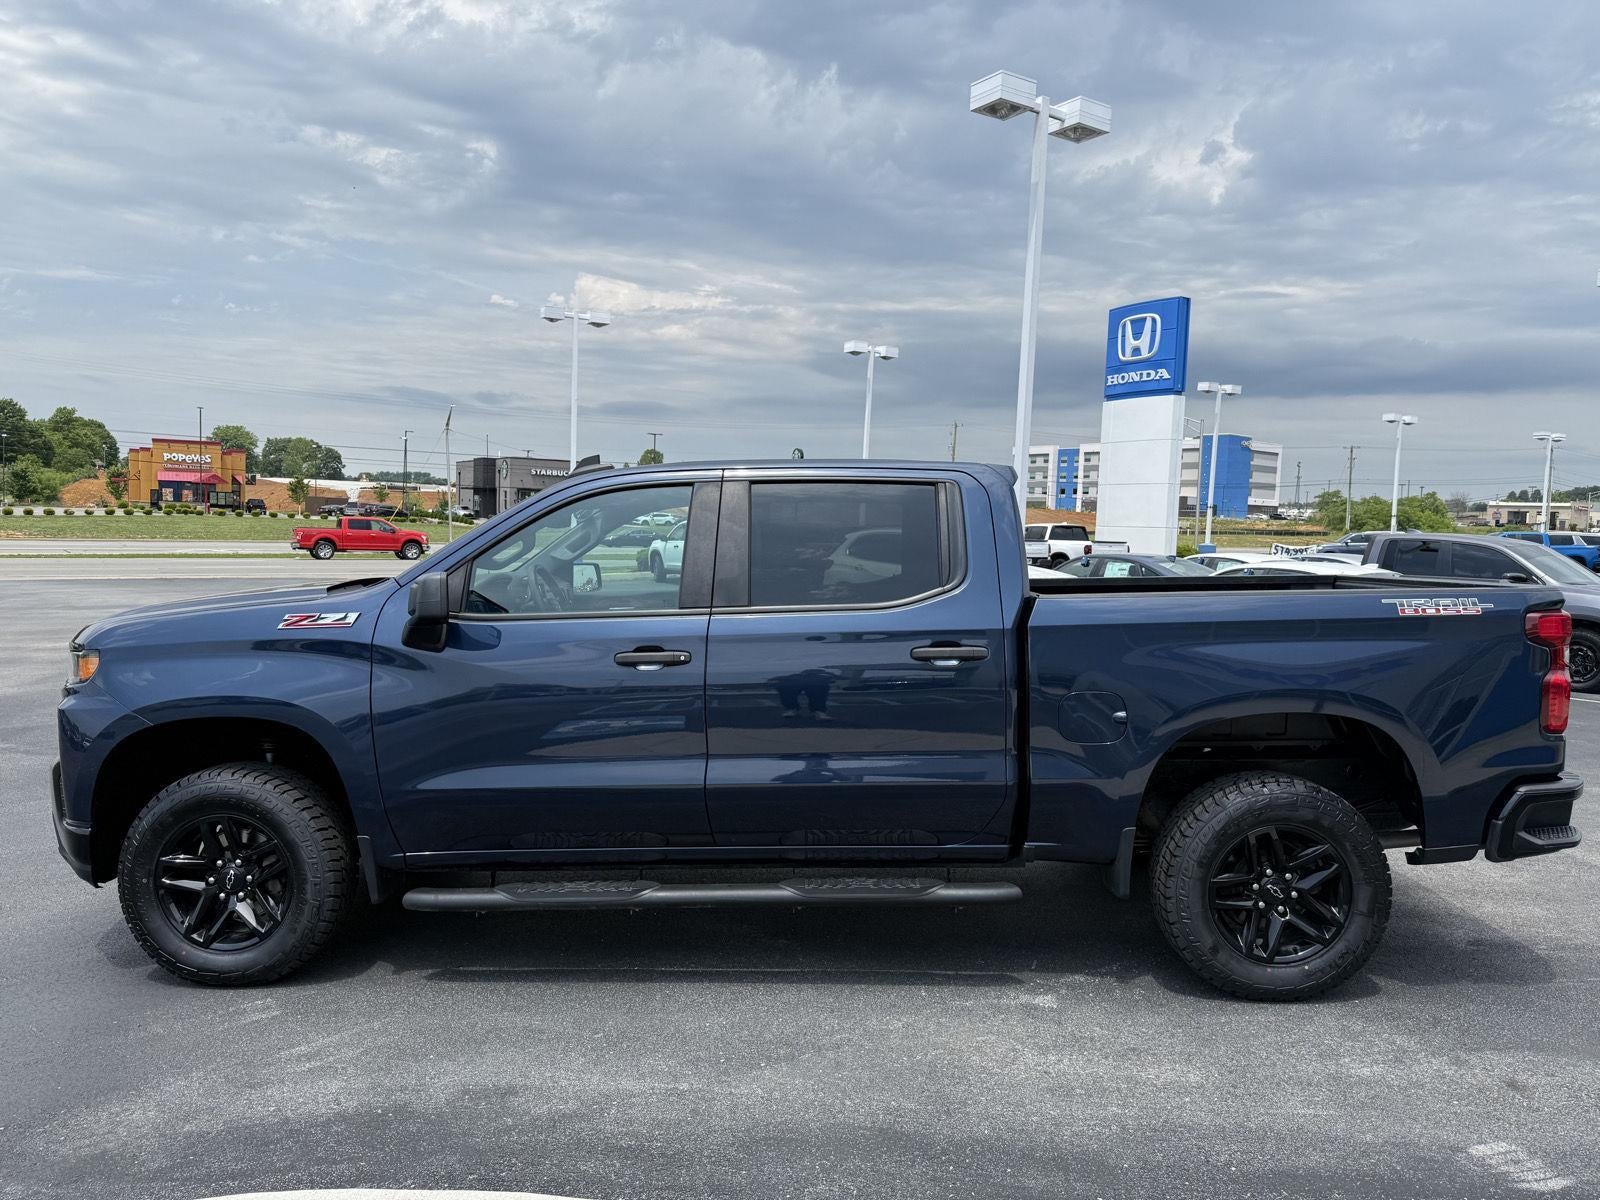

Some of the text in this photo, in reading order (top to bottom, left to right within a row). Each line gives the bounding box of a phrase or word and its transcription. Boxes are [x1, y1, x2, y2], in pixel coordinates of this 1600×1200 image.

[1106, 368, 1171, 386] HONDA
[530, 468, 569, 477] STARBUC
[1381, 598, 1494, 609] TRAIL
[1399, 607, 1482, 616] BOSS
[277, 612, 361, 630] Z71
